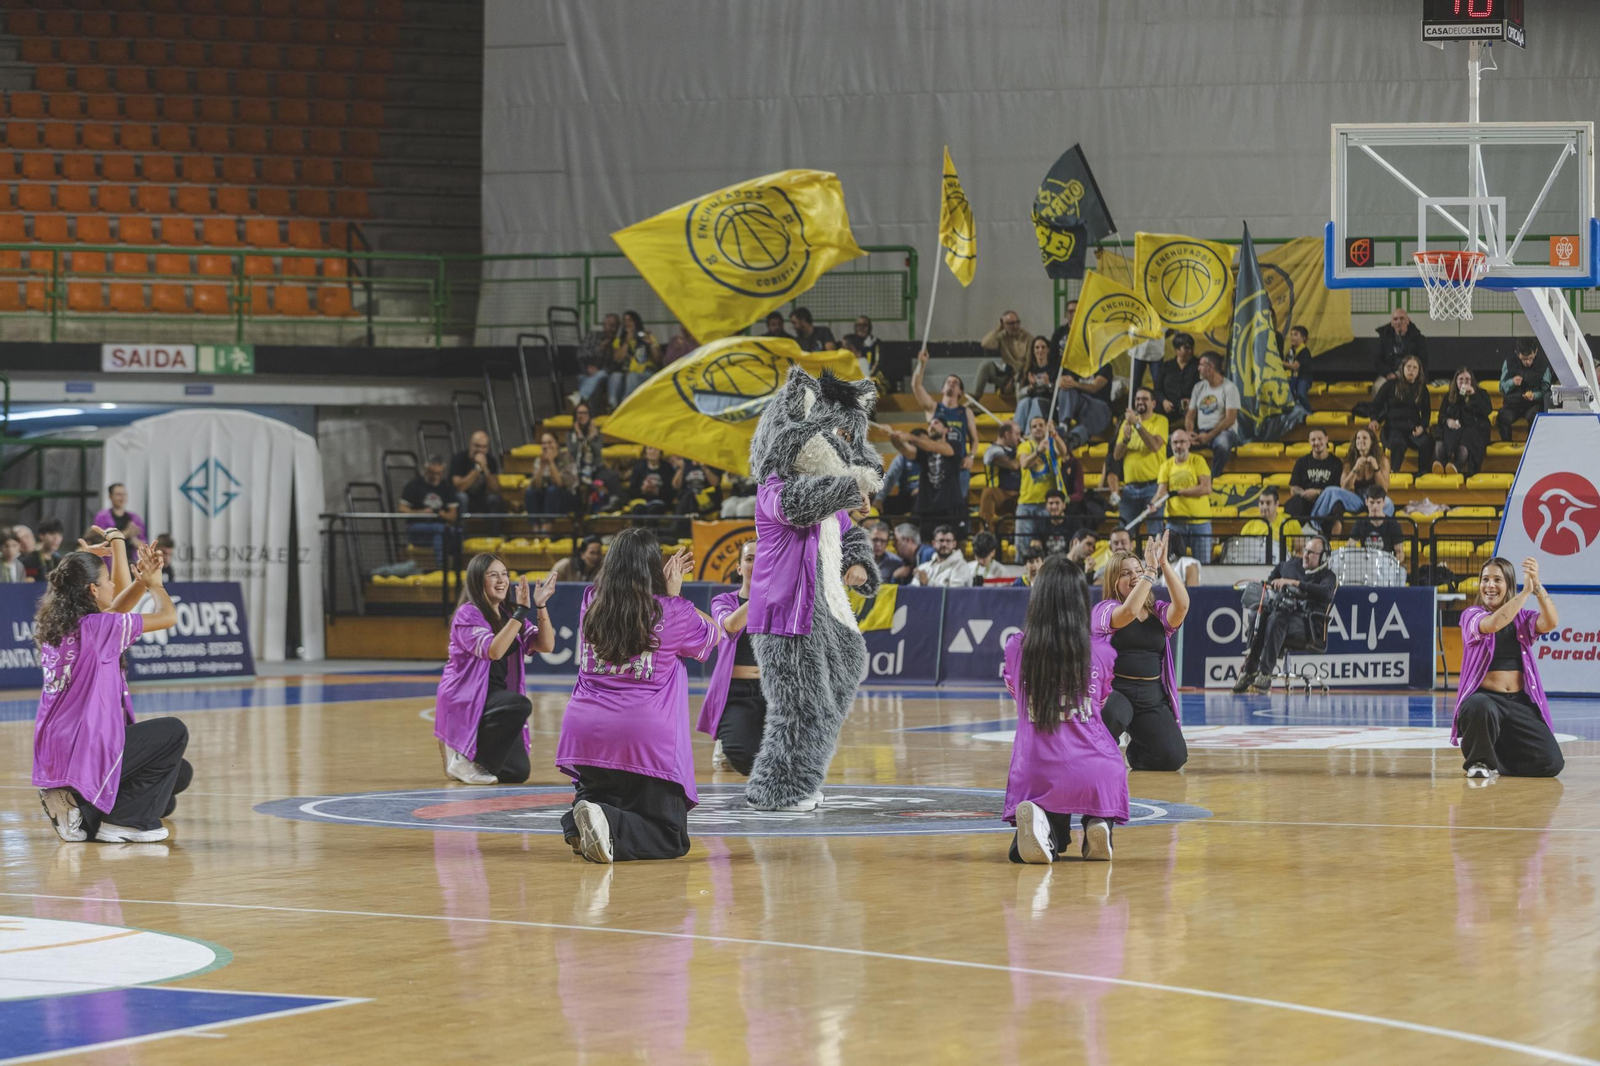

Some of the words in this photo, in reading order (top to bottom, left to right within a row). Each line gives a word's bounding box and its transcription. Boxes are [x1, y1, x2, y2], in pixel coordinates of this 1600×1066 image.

[1426, 26, 1500, 35] CASADELOSLENTES
[1155, 248, 1212, 267] ENCHUFADOS
[112, 348, 187, 368] SAIDA
